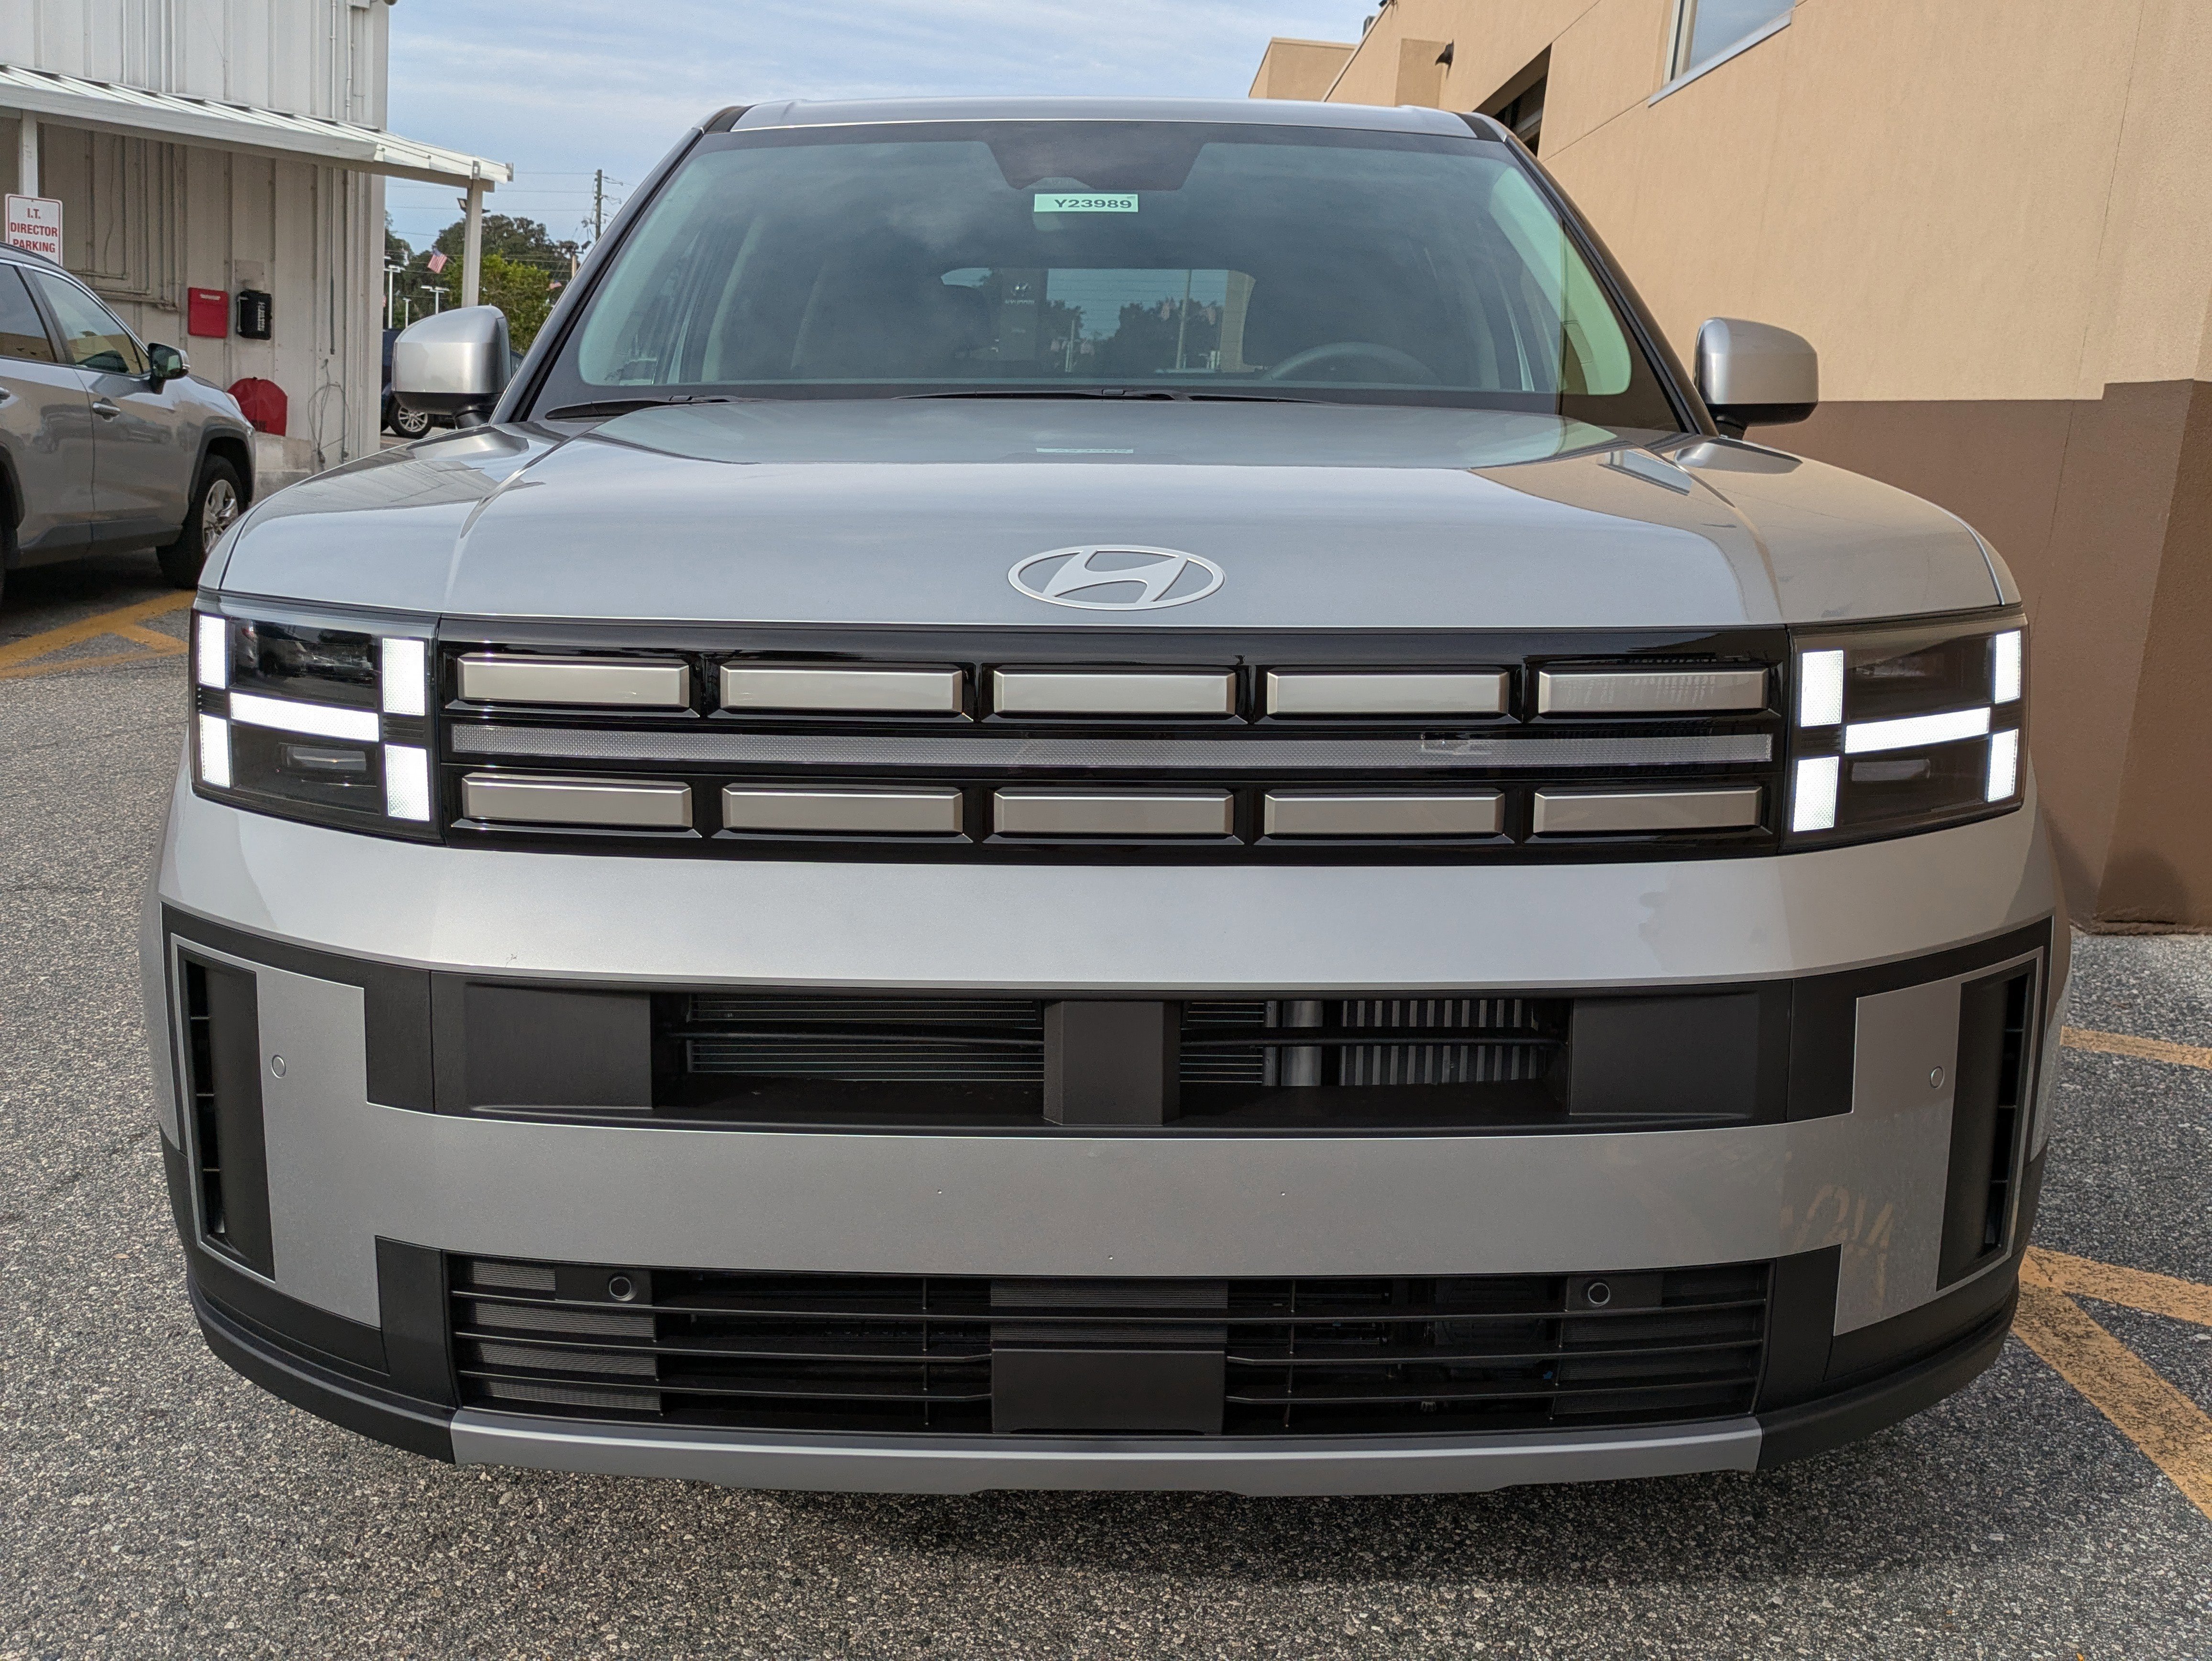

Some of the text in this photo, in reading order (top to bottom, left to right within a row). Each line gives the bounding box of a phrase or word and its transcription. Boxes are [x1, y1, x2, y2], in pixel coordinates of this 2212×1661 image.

[1054, 199, 1132, 208] Y23989
[27, 208, 41, 219] I.T.
[10, 222, 57, 237] DIRECTOR
[12, 239, 55, 253] PARKING
